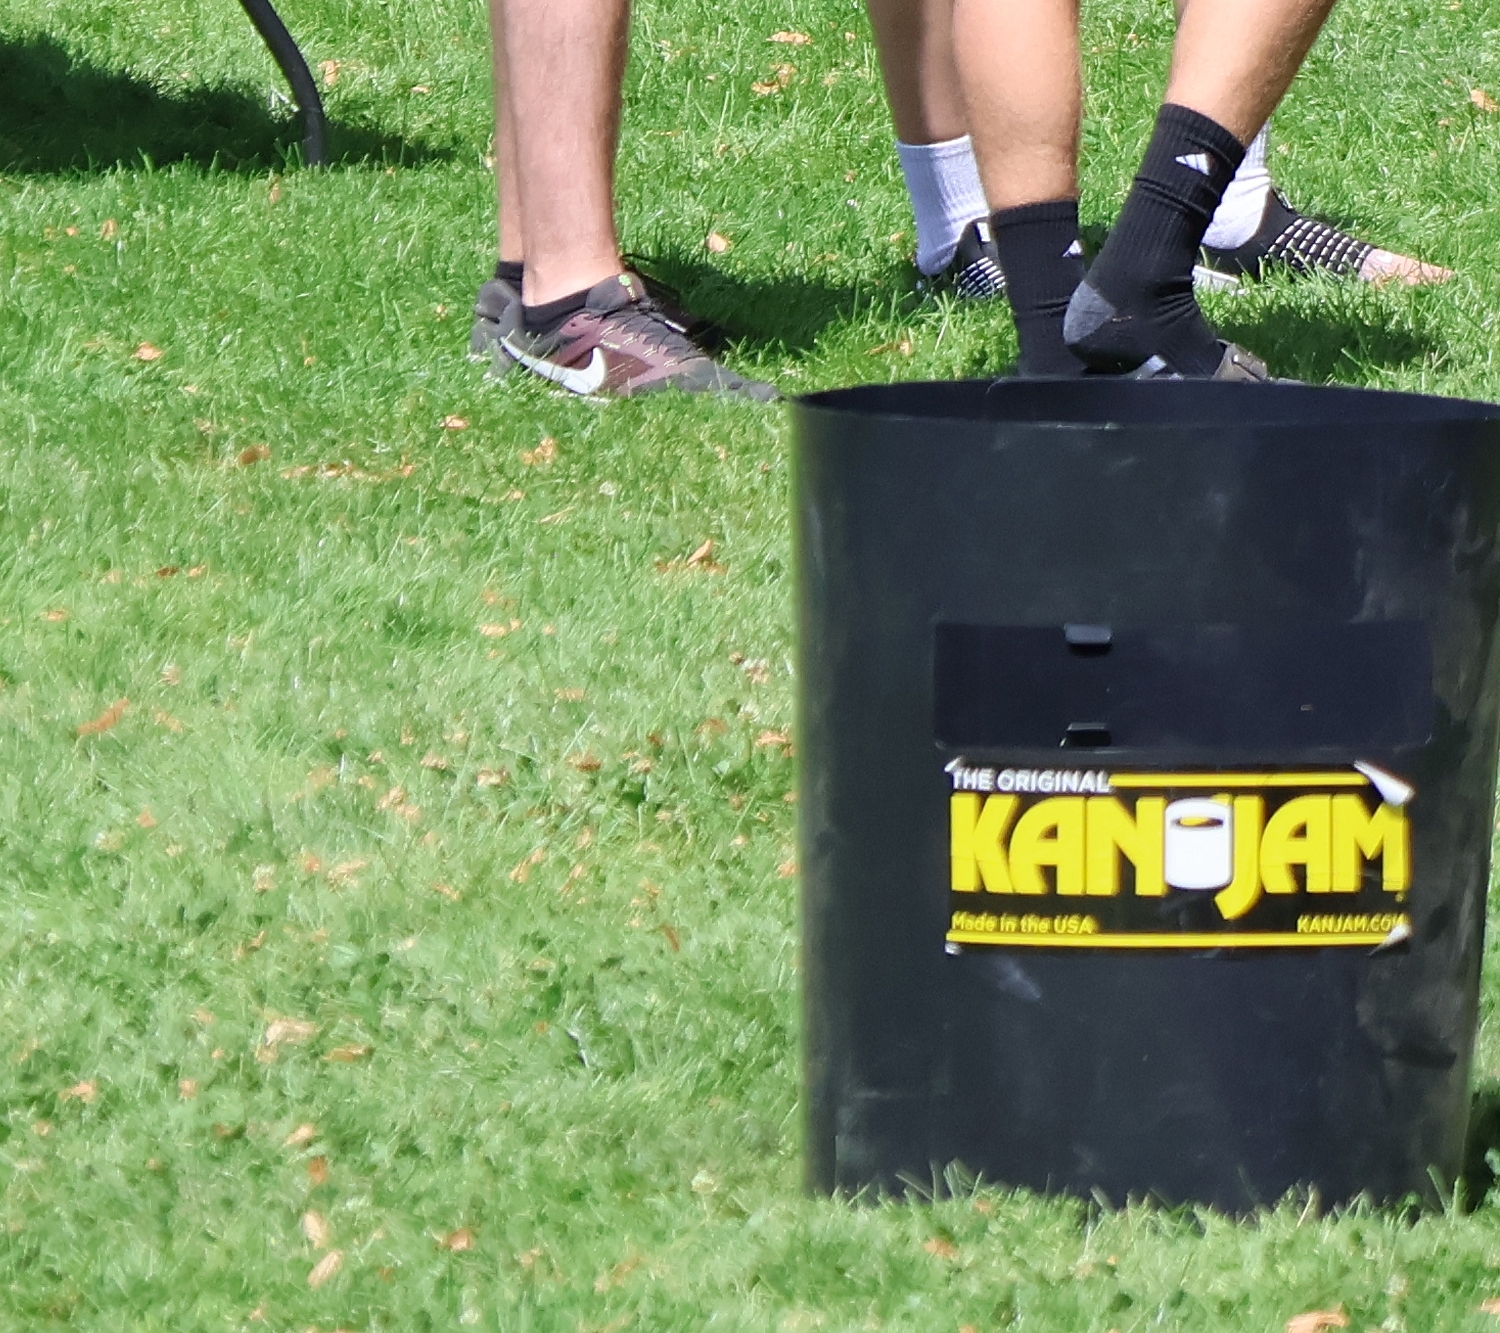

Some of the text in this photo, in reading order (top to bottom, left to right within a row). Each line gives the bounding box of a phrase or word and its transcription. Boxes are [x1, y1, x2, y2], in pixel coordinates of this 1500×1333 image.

[953, 767, 1112, 793] THE ORIGINAL
[951, 910, 1096, 934] Made in the USA
